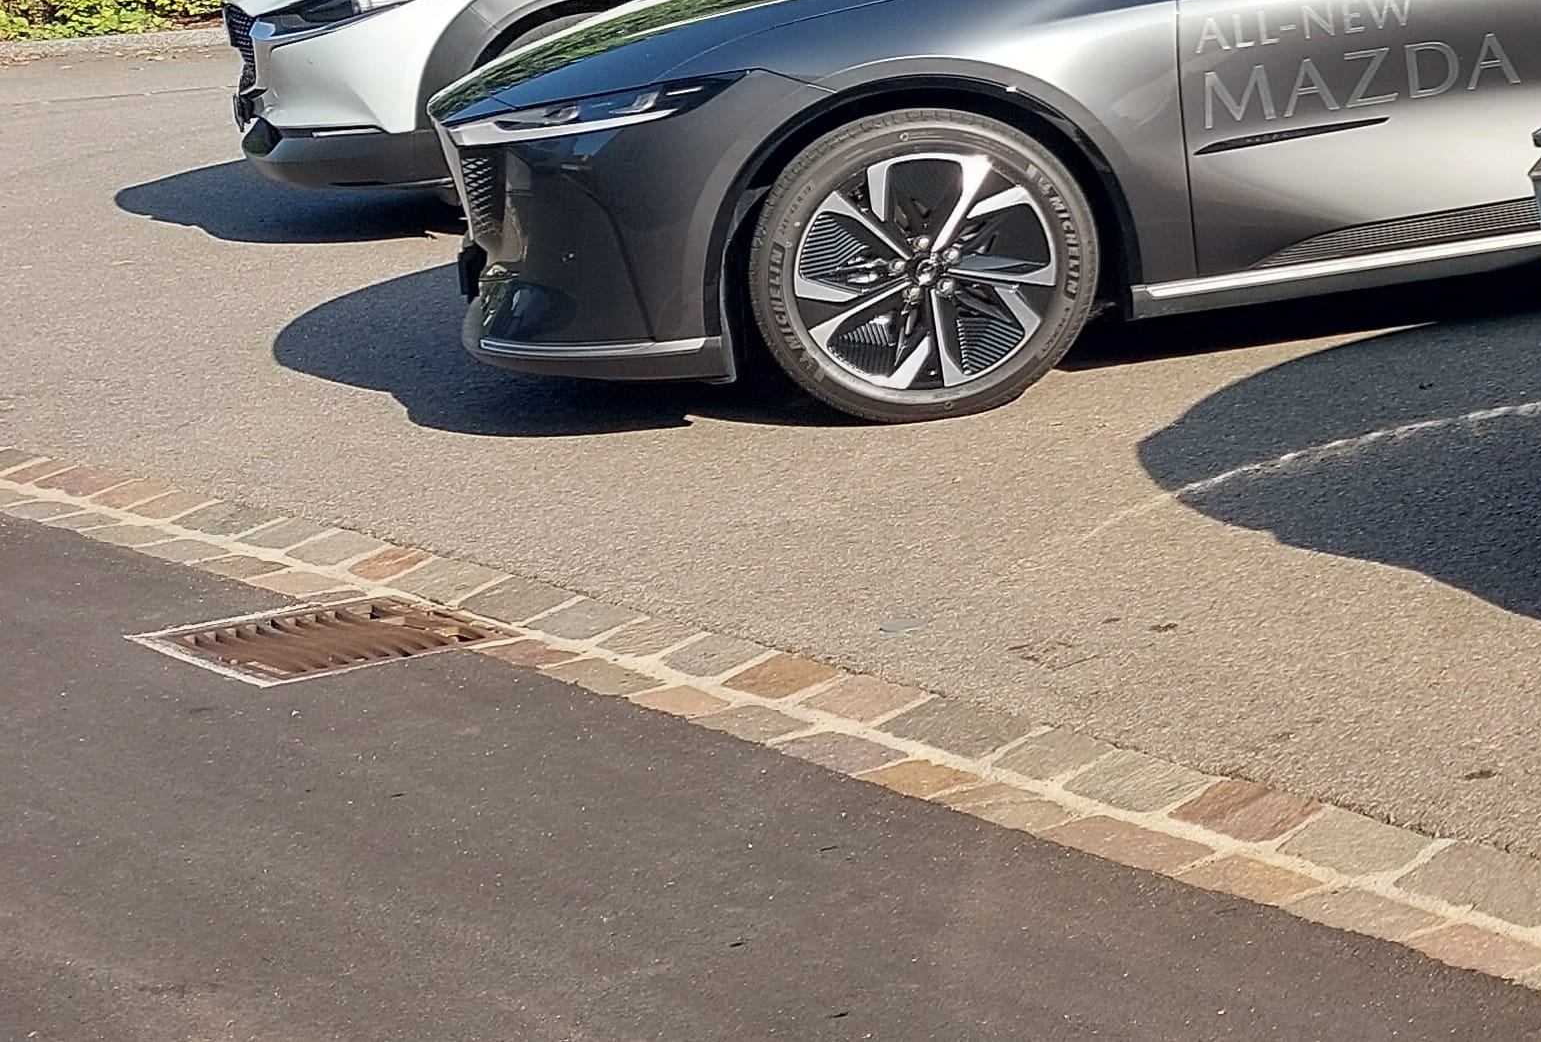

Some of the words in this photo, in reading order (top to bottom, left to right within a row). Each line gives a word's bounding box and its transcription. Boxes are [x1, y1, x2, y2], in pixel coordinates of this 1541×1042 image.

[1203, 33, 1522, 129] MAZDA
[1050, 194, 1080, 296] MICHELIN
[769, 244, 803, 351] MICHELIN
